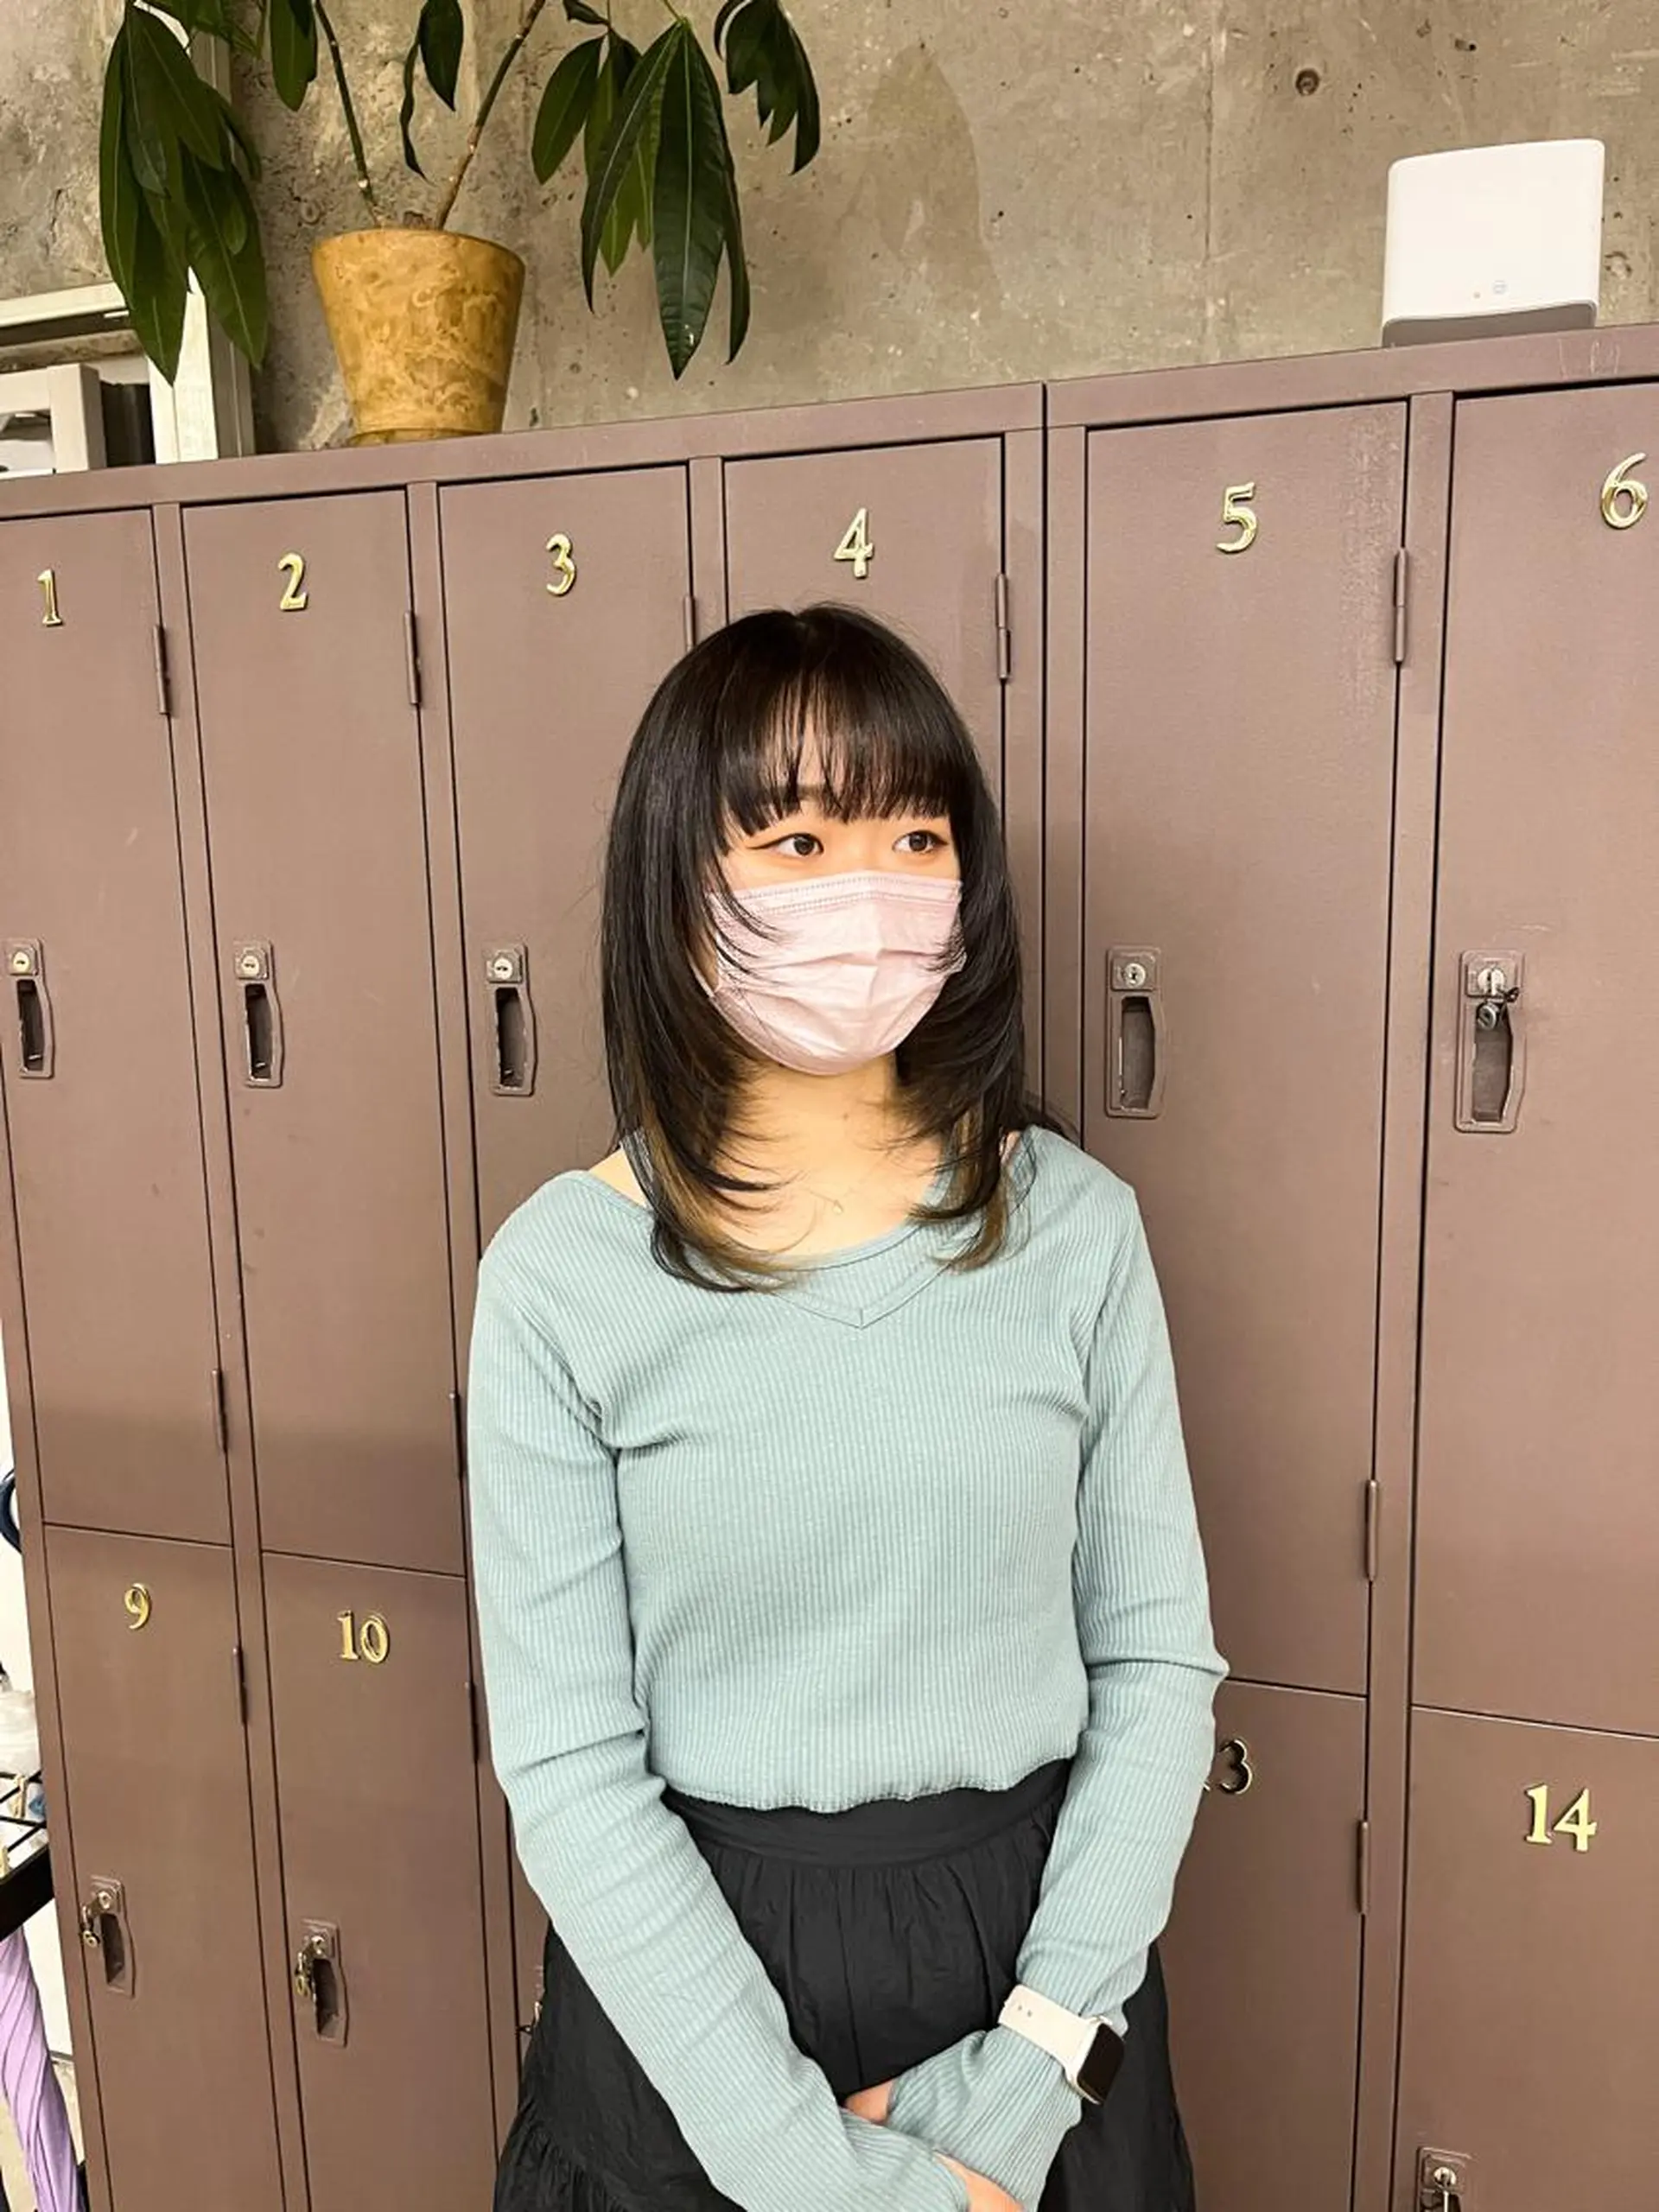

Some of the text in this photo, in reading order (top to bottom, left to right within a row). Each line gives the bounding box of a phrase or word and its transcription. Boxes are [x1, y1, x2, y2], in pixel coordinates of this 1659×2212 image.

[1217, 482, 1258, 554] 5
[1599, 452, 1649, 530] 6
[545, 533, 577, 596] 3
[834, 508, 874, 580] 4
[38, 569, 63, 626] 1
[277, 552, 308, 612] 2
[124, 1583, 152, 1630] 9
[337, 1610, 391, 1664] 10
[1205, 1738, 1254, 1796] 3
[1523, 1783, 1598, 1853] 14
